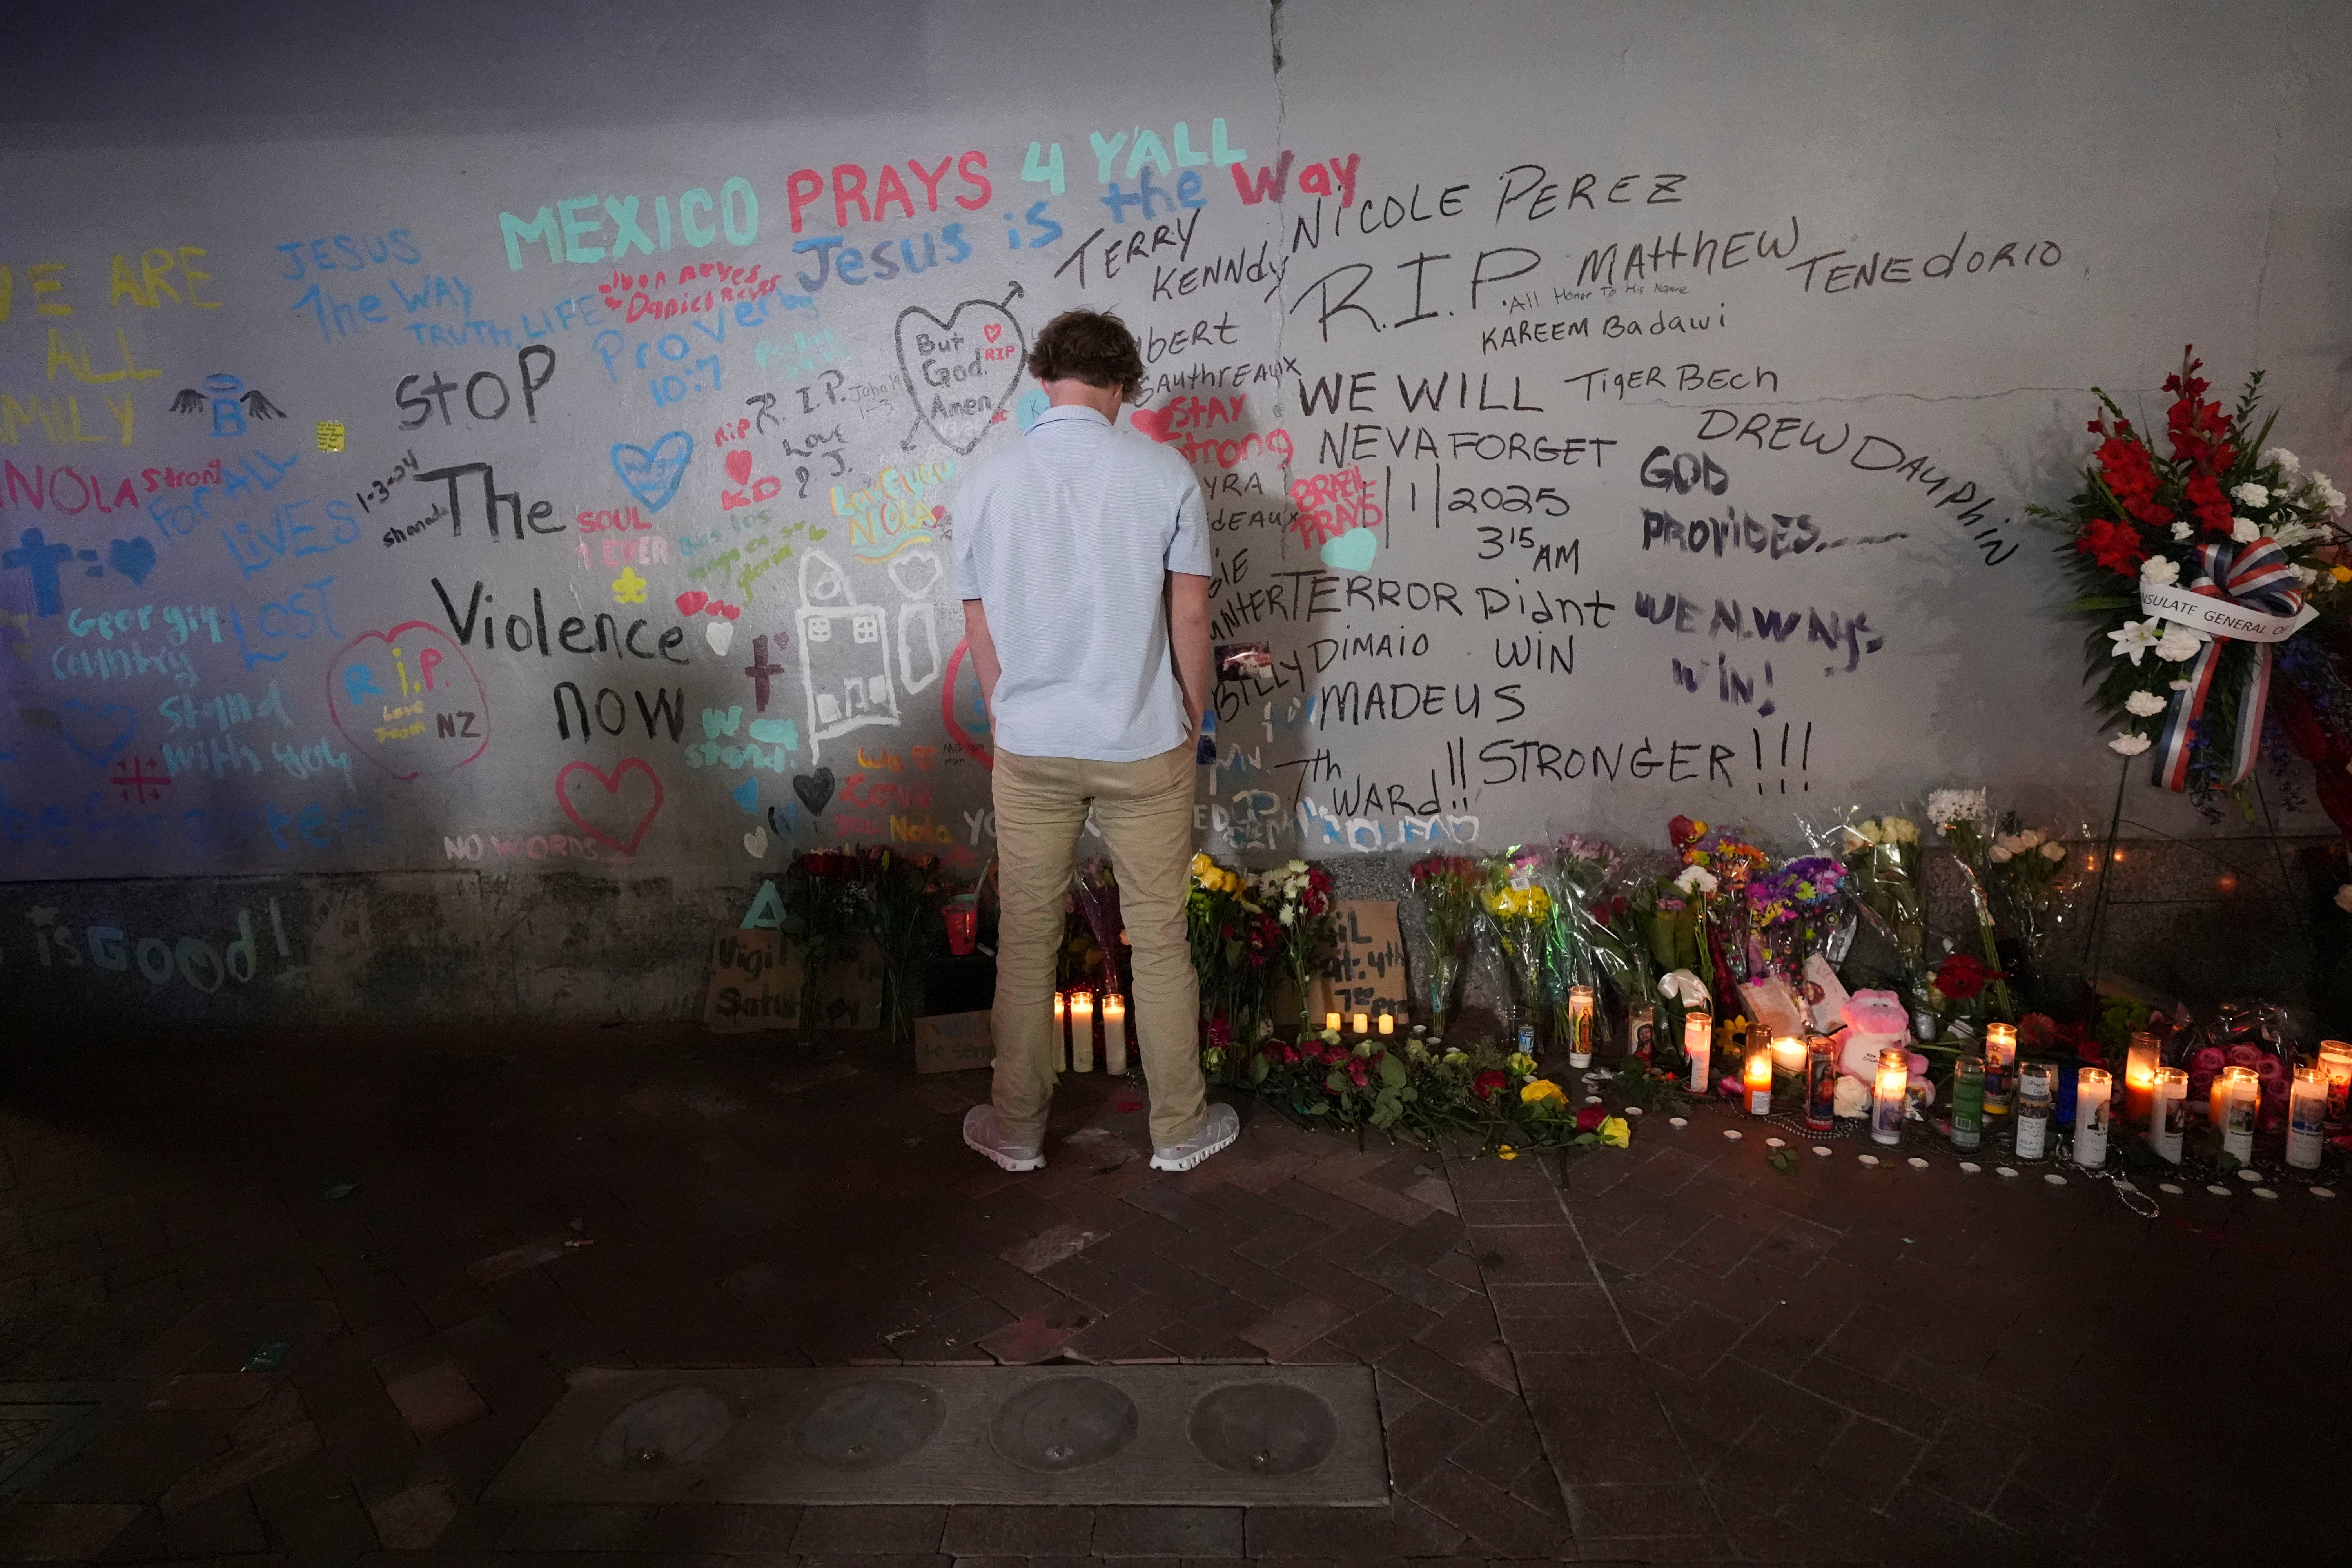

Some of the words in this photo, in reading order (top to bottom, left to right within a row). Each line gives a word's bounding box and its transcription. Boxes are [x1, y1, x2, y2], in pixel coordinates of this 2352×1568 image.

[499, 176, 759, 271] MEXICO
[786, 150, 992, 233] PRAYS
[1021, 141, 1065, 196] 4
[1495, 164, 1688, 223] PEREZ
[792, 222, 972, 292] Jesus
[1004, 201, 1063, 249] is
[1100, 166, 1208, 223] the
[1054, 208, 1201, 289] TERRY
[110, 247, 222, 309] ARE
[276, 229, 423, 281] JESUS
[916, 333, 964, 356] But
[985, 345, 1015, 361] RIP
[1482, 318, 1590, 355] KAREEM
[1602, 303, 1726, 339] Badawi
[46, 326, 163, 385] ALL
[931, 393, 992, 420] Amen
[1298, 372, 1377, 417] WE
[1397, 371, 1544, 412] WILL
[1319, 421, 1439, 469] NEVA
[1448, 431, 1619, 468] FORGET
[1697, 409, 1849, 456] DREW
[4, 459, 140, 515] NOLA
[1203, 472, 1263, 500] YRA
[1640, 446, 1729, 496] GOD
[412, 463, 567, 543] The
[576, 506, 653, 534] SOUL
[849, 498, 938, 546] NOLA
[1290, 493, 1384, 550] PRAYS
[601, 535, 670, 568] EVER
[431, 577, 690, 665] Violence
[1271, 568, 1463, 624] TERROR
[2203, 610, 2266, 635] GENERAL
[436, 711, 481, 739] NZ
[443, 835, 485, 862] NO
